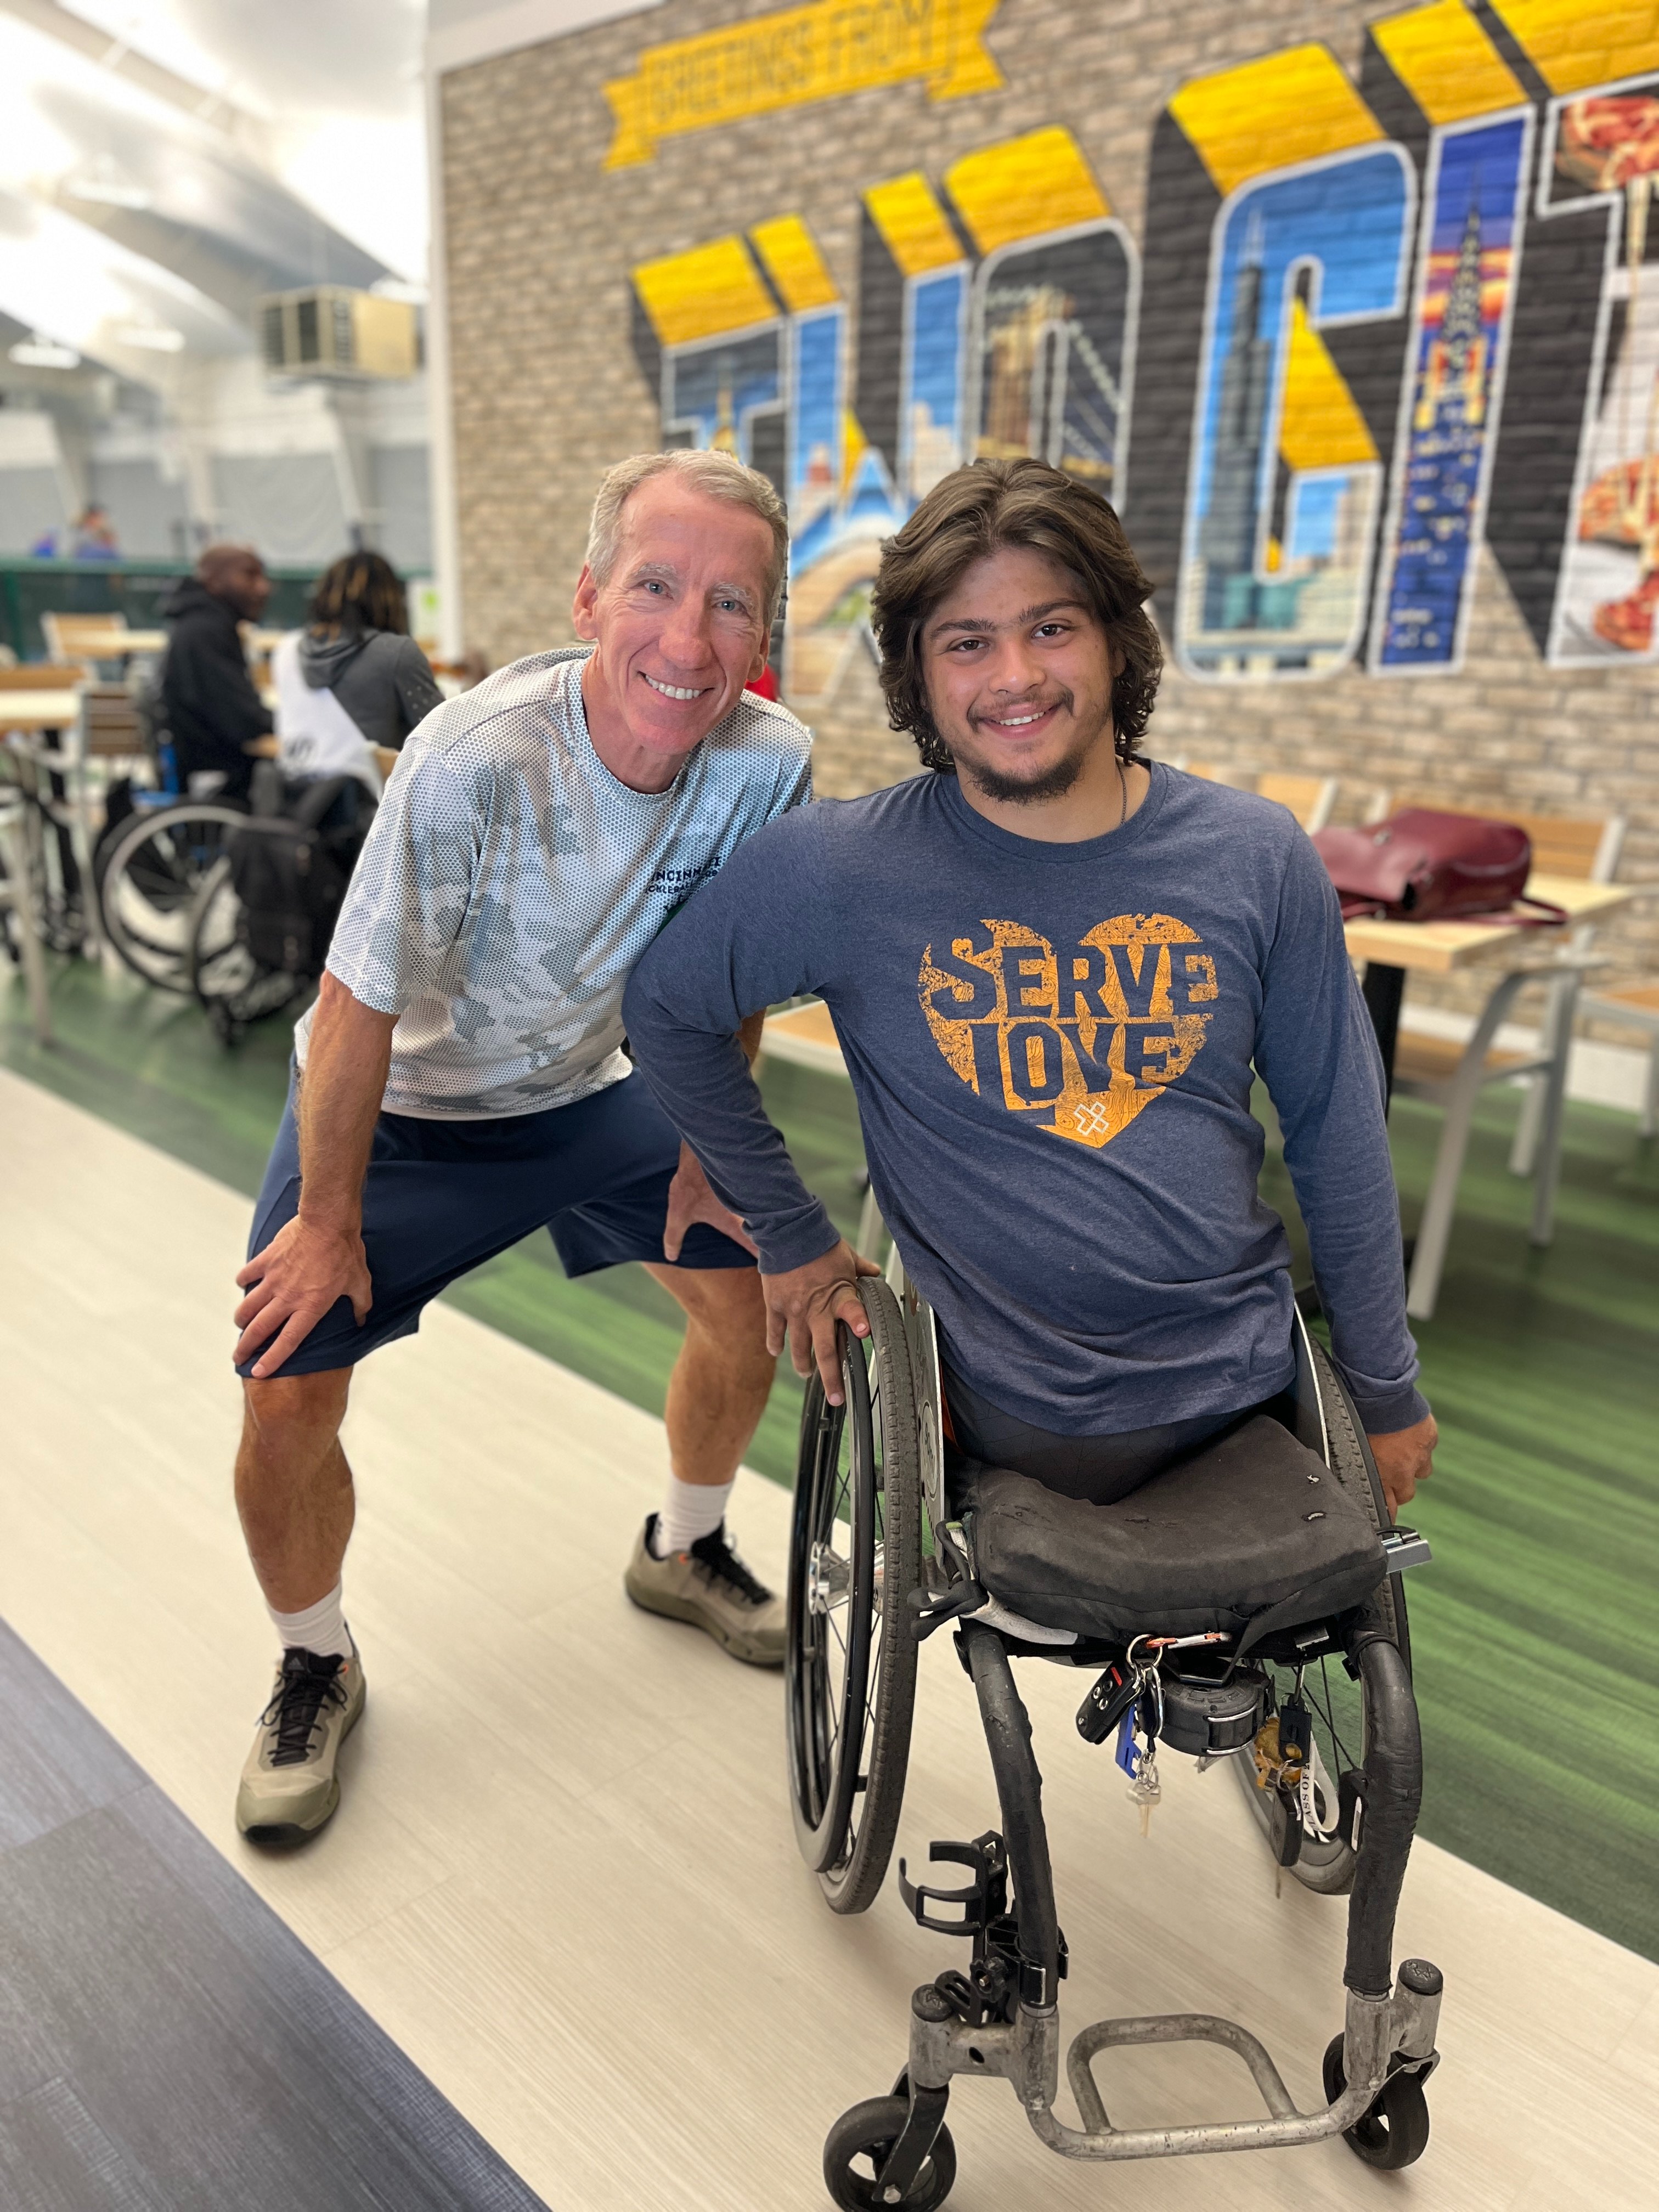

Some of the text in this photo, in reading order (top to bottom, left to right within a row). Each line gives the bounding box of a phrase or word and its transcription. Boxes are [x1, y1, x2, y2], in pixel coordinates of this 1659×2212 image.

[928, 927, 1218, 1020] SERVE
[972, 1020, 1175, 1127] LOVE
[1302, 1773, 1310, 1790] OF
